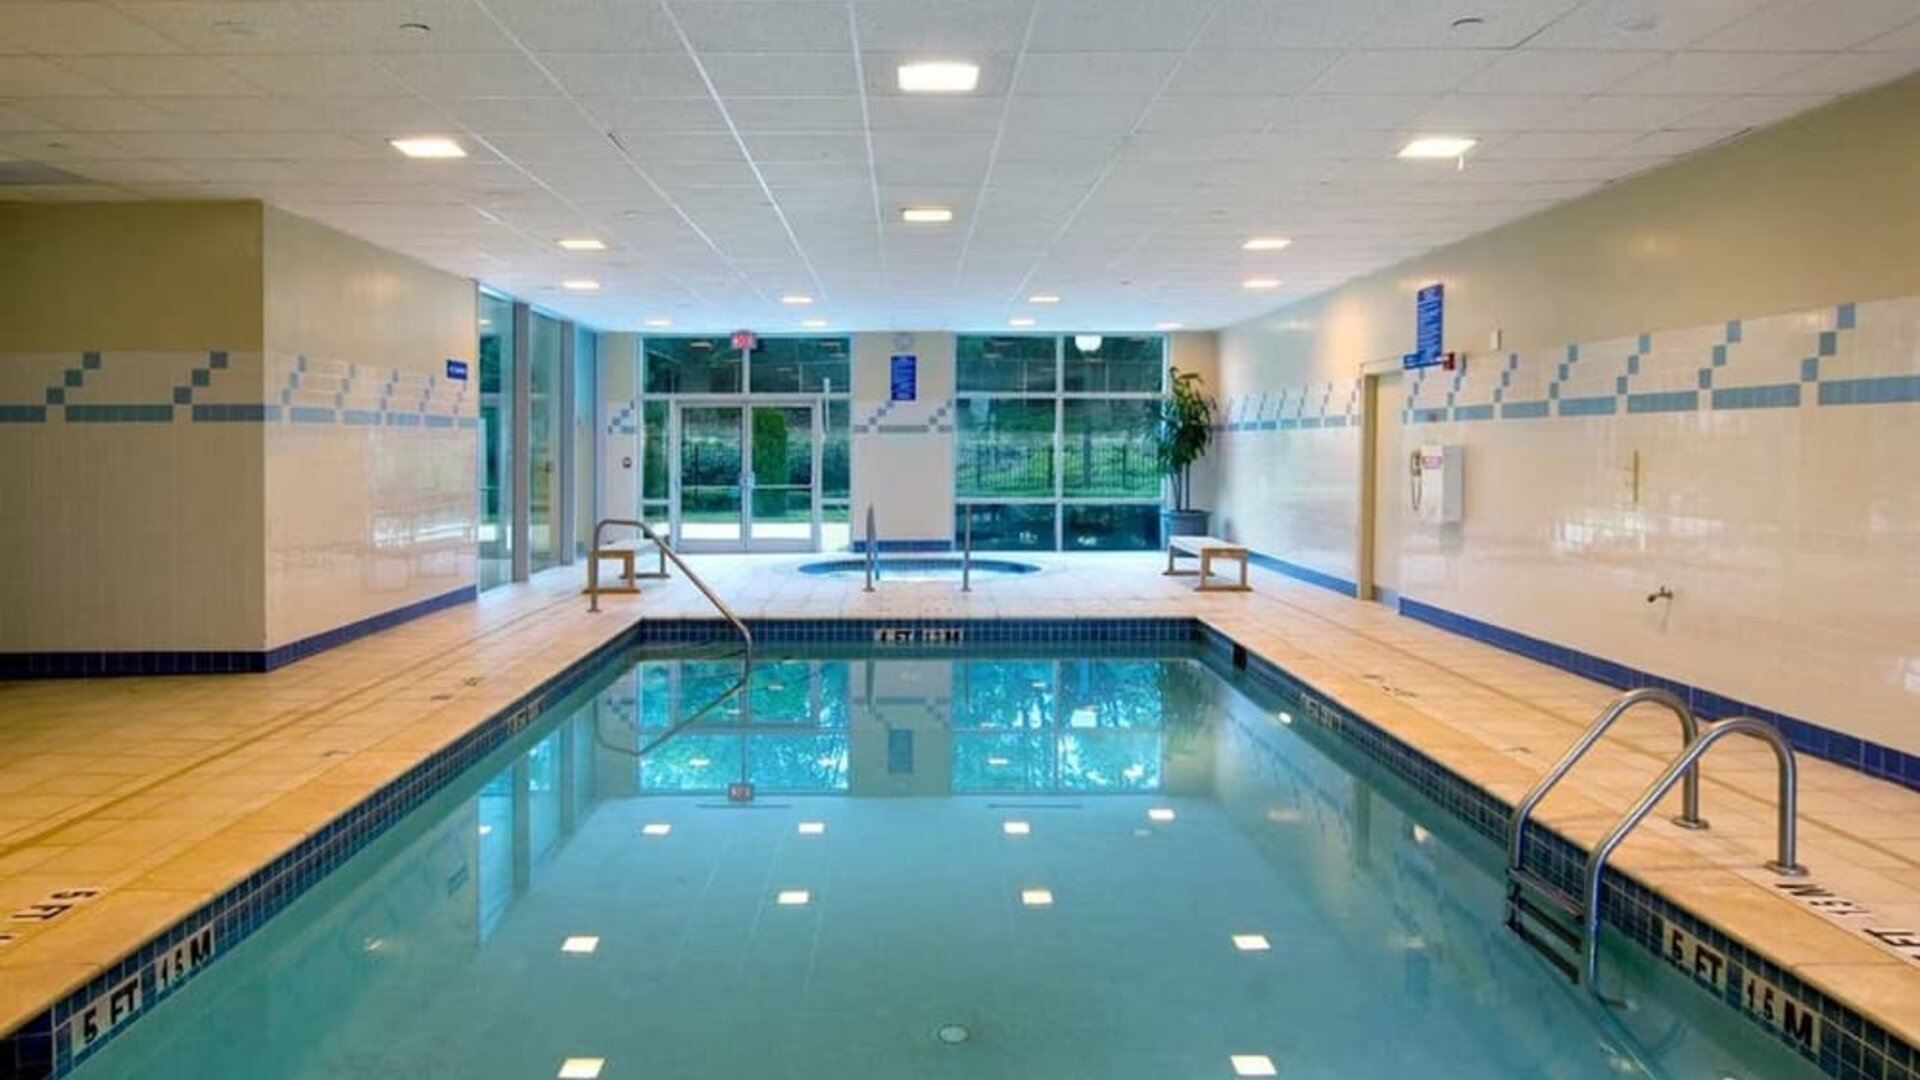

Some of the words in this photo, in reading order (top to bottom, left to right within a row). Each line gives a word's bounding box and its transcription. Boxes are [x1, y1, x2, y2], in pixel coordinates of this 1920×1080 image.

[1670, 928, 1685, 965] 5
[1694, 944, 1725, 985] FT
[82, 1006, 99, 1046] 5
[108, 975, 139, 1026] FT
